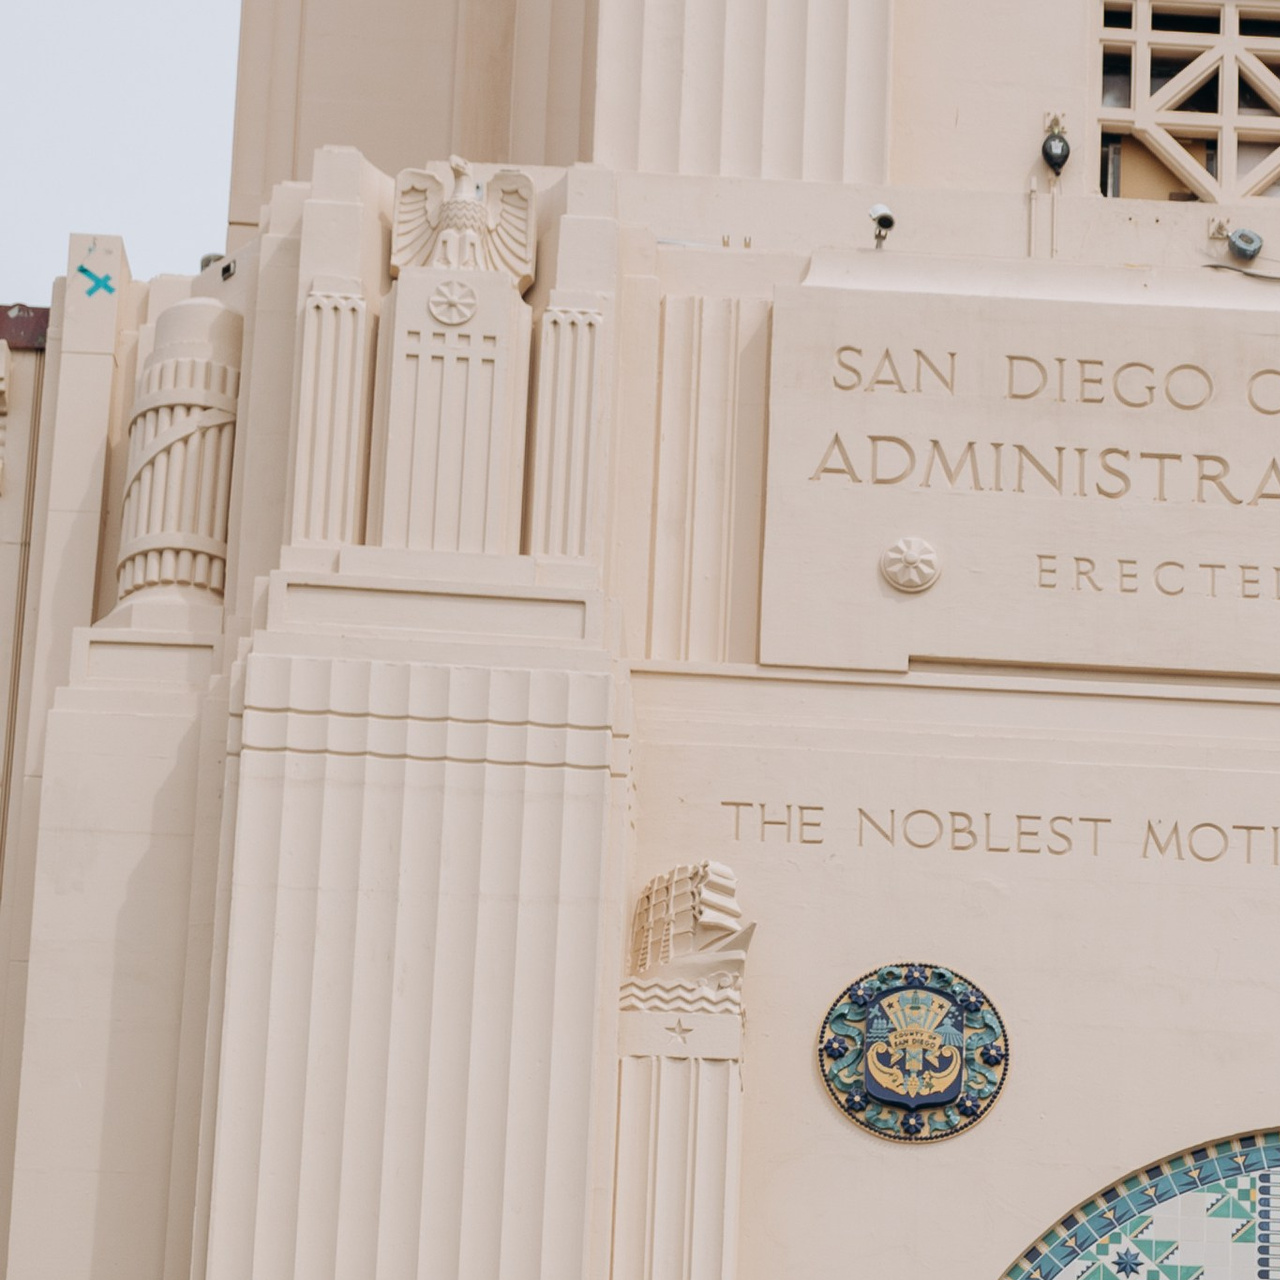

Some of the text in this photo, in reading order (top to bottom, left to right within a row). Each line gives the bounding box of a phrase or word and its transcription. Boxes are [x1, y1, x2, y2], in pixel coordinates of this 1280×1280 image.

[833, 345, 957, 395] SAN
[1004, 355, 1214, 411] DIEGO
[721, 801, 824, 845] THE
[856, 808, 1112, 857] NOBLEST
